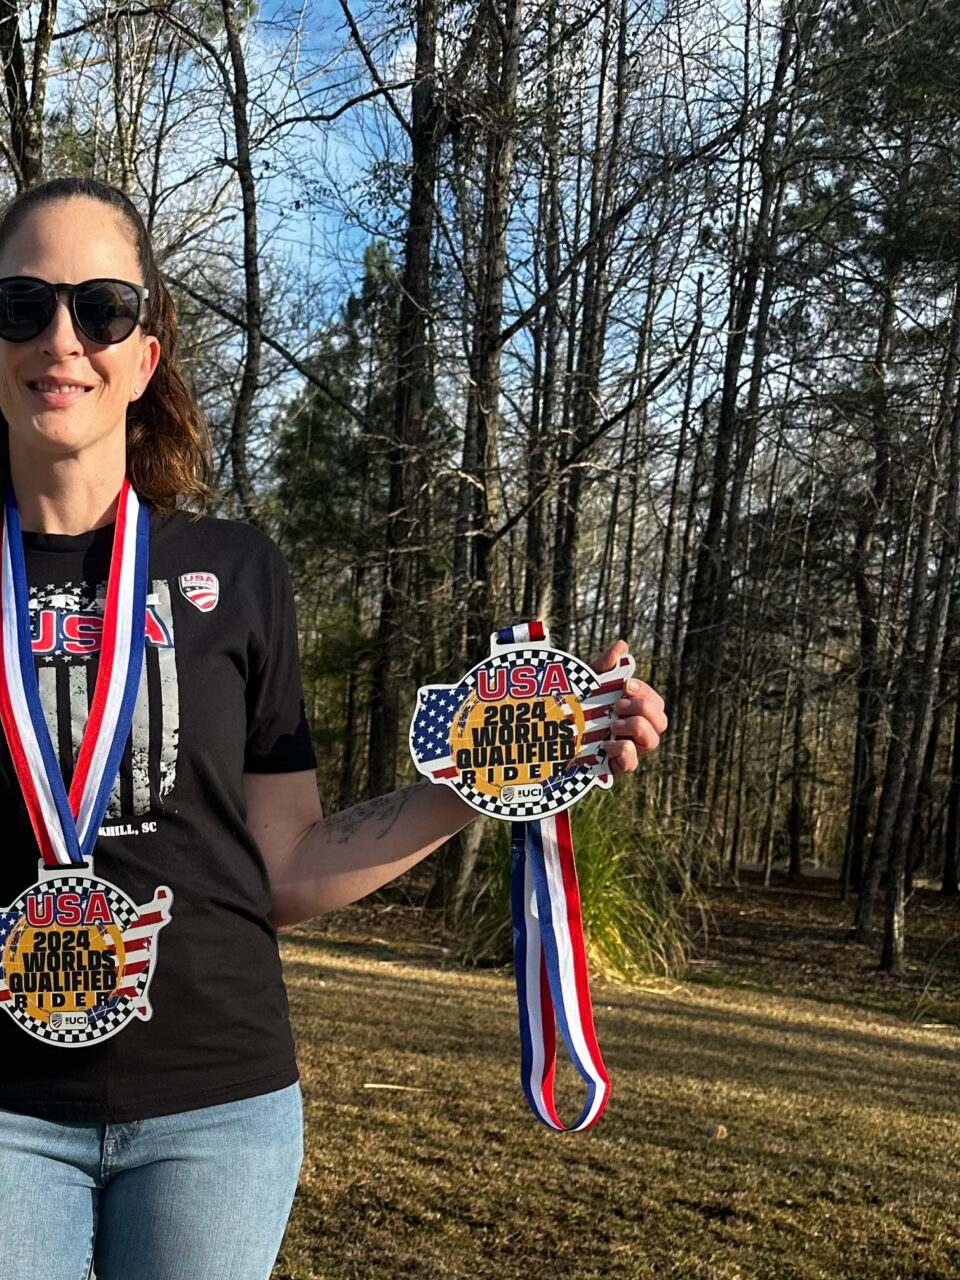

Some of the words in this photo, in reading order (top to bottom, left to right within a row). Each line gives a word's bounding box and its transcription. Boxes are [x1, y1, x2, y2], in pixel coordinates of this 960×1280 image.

[184, 575, 215, 584] USA
[477, 662, 572, 700] USA
[484, 701, 547, 726] 2024
[472, 719, 573, 748] WORLDS
[456, 740, 575, 769] QUALIFIED
[462, 762, 567, 785] RIDER
[523, 788, 542, 798] UCI
[98, 824, 139, 837] KHILL,
[141, 821, 157, 833] SC
[27, 892, 113, 927] USA
[33, 930, 91, 951] 2024
[23, 950, 116, 972] WORLDS
[9, 971, 117, 993] QUALIFIED
[13, 991, 110, 1008] RIDER
[69, 1016, 87, 1025] UCI
